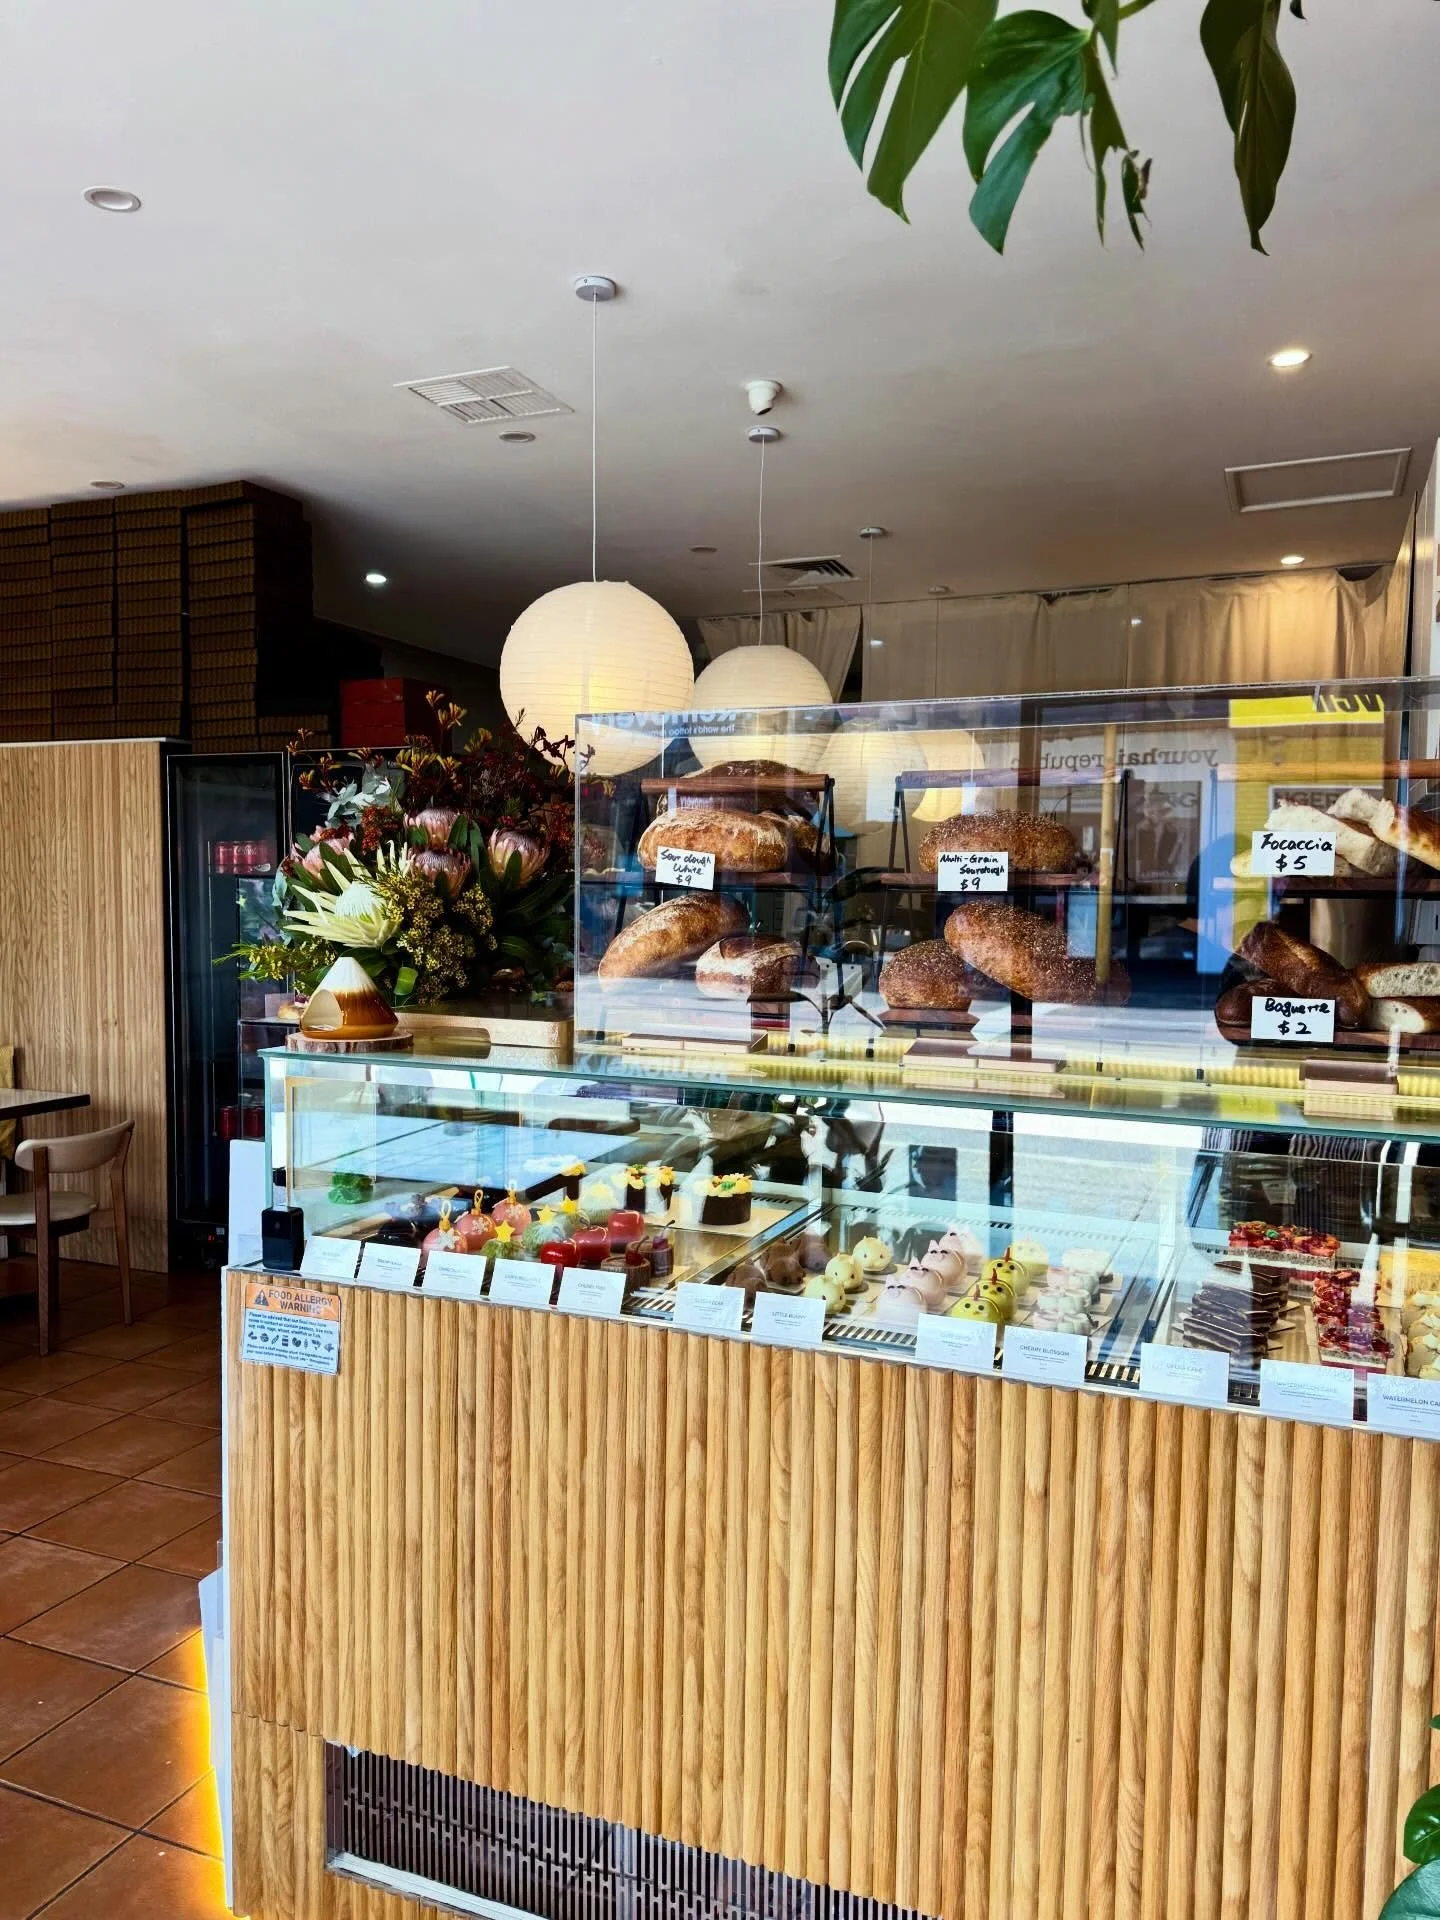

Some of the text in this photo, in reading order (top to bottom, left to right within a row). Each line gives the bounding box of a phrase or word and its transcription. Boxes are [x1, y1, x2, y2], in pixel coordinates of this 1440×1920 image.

[1260, 832, 1333, 852] Focaccia
[672, 863, 704, 875] White
[1275, 854, 1306, 872] $5
[675, 874, 692, 886] $9
[960, 876, 981, 890] $9
[1264, 998, 1331, 1019] Baguette
[1278, 1022, 1312, 1037] $2
[268, 1290, 333, 1306] FOOD ALLERGY
[280, 1300, 322, 1314] WARNING
[1020, 1344, 1070, 1356] CHERRY BLOSSOM
[1382, 1394, 1429, 1405] WATERMELON
